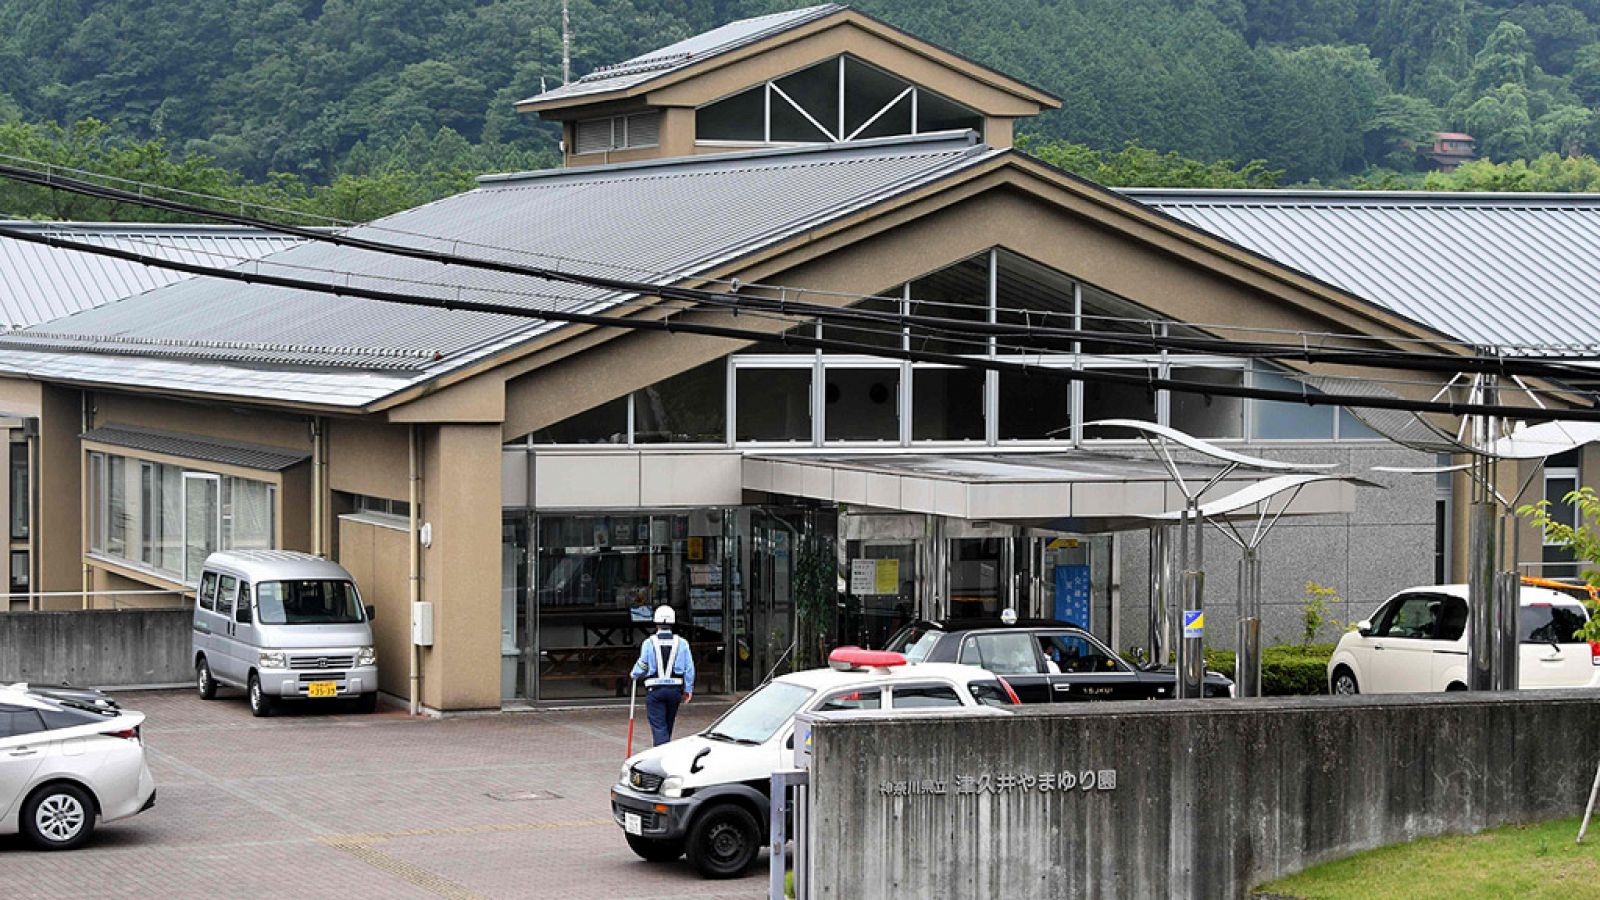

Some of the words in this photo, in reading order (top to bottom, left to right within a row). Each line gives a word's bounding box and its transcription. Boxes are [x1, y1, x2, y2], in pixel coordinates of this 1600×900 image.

[880, 779, 947, 796] 神奈川県立
[955, 769, 1117, 794] 津久井やまゆり園
